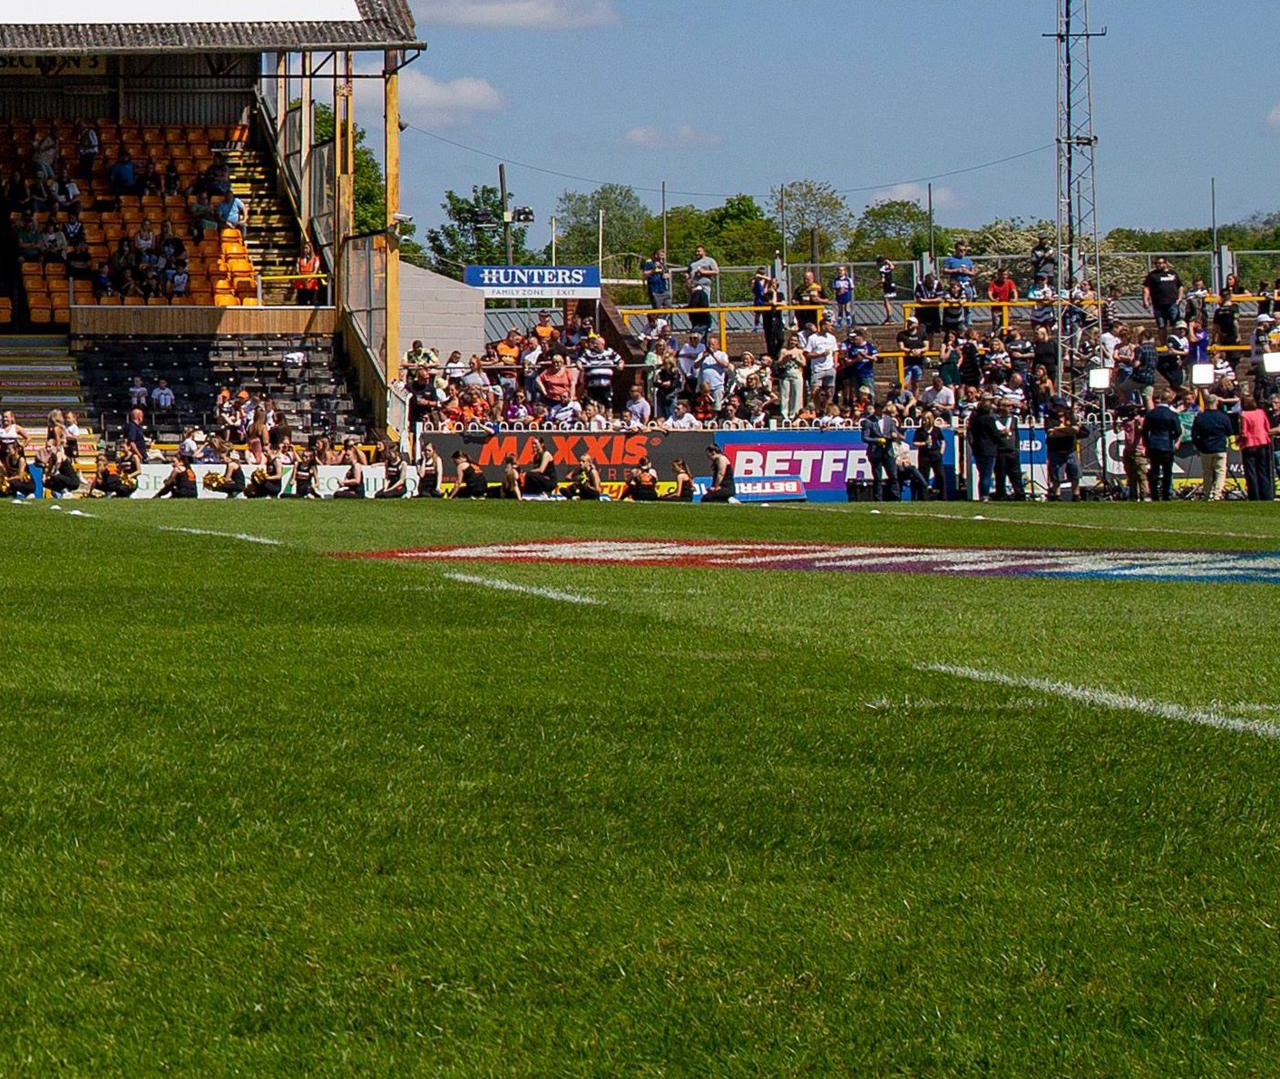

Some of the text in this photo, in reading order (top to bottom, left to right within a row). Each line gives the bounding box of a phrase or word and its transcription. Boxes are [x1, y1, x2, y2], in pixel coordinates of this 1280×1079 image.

[479, 268, 584, 284] HUNTERS
[733, 450, 872, 483] BETFR
[735, 481, 798, 495] BETFR
